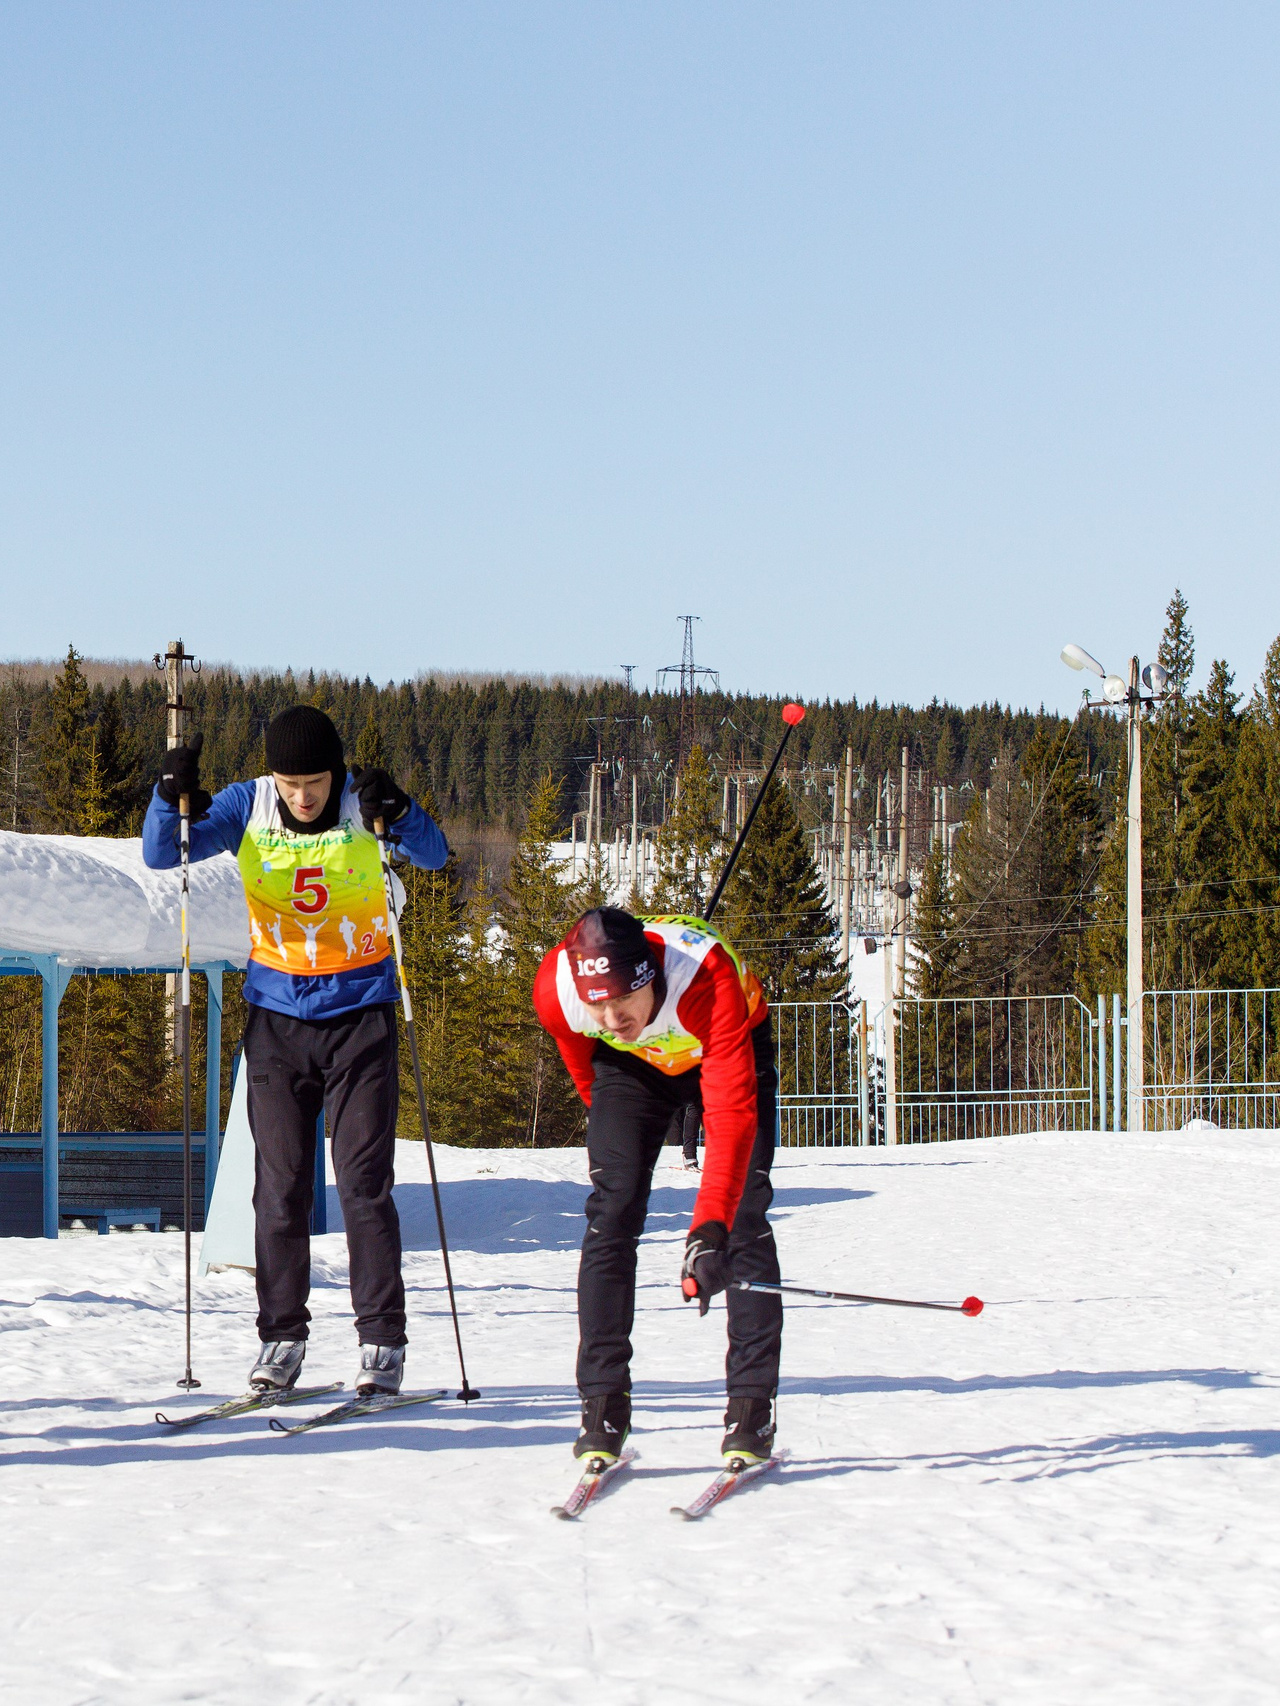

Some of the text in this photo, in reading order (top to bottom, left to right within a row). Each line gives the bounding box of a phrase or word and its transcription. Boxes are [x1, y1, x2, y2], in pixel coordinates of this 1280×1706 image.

[291, 865, 330, 916] 5
[360, 932, 376, 957] 2
[577, 953, 610, 976] ice
